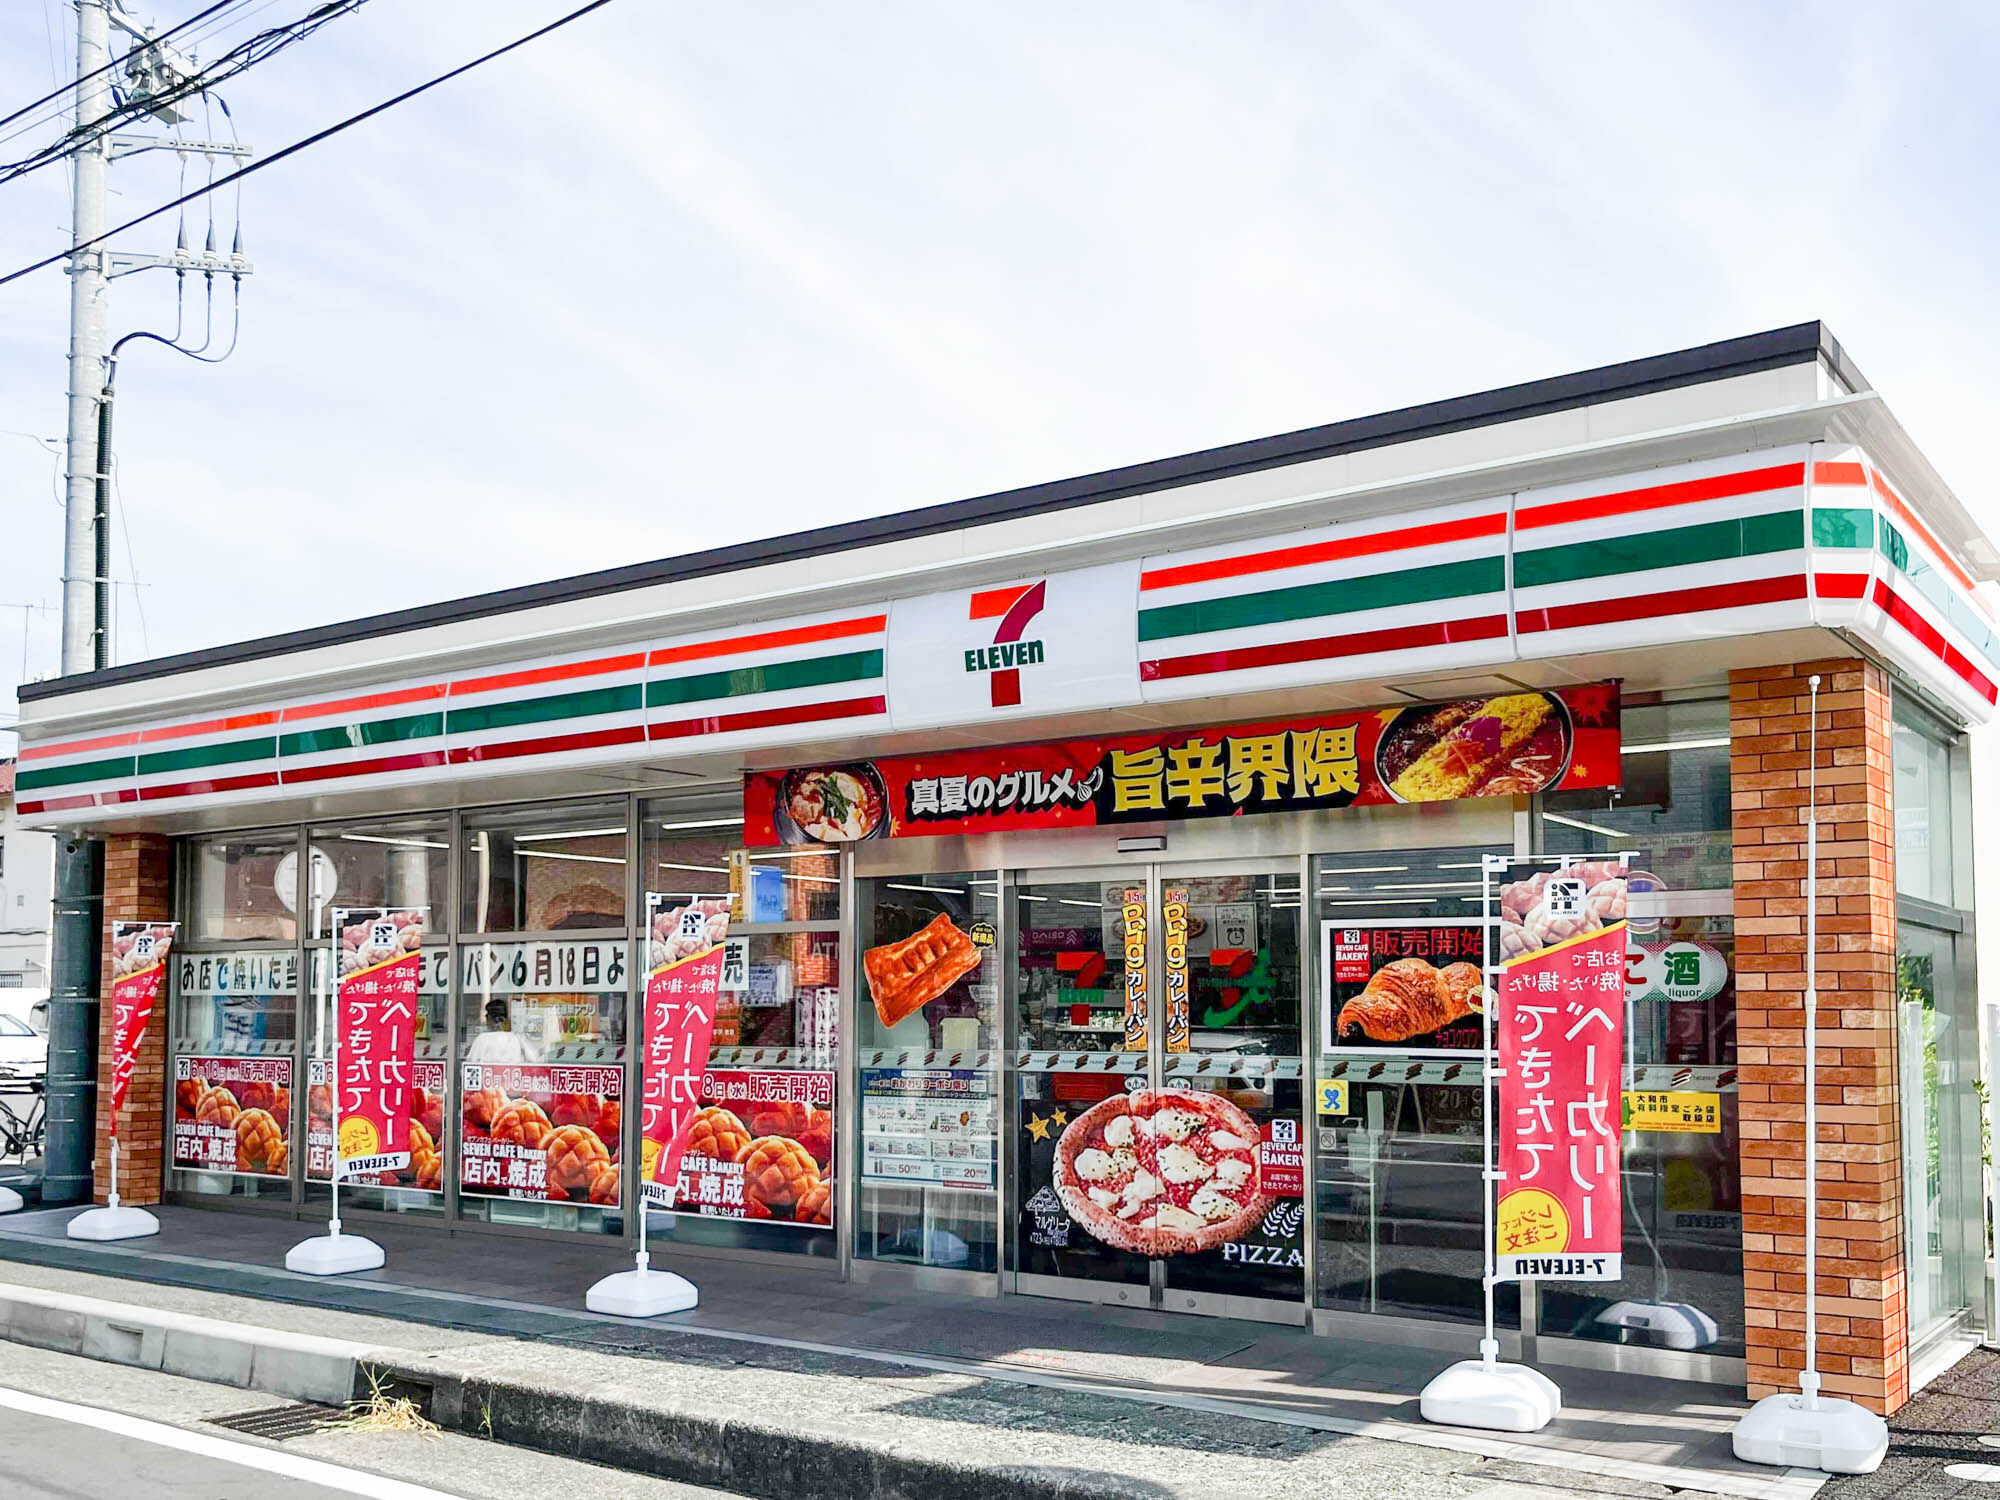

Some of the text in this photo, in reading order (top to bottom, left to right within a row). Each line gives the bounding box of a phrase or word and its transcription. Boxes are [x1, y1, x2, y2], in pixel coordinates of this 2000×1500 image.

[910, 722, 1361, 816] 真夏のグルメ 旨辛界隈
[723, 942, 743, 984] 売
[1335, 952, 1368, 961] BAKERY
[1664, 951, 1701, 986] 酒
[1668, 988, 1702, 999] liquor
[463, 1142, 491, 1156] SEVEN
[493, 1144, 516, 1158] CAFE
[1261, 1141, 1286, 1152] SEVEN
[681, 1156, 707, 1172] CAFE
[898, 1164, 910, 1174] 50
[963, 1168, 976, 1178] 20
[1223, 1243, 1304, 1268] PIZZA
